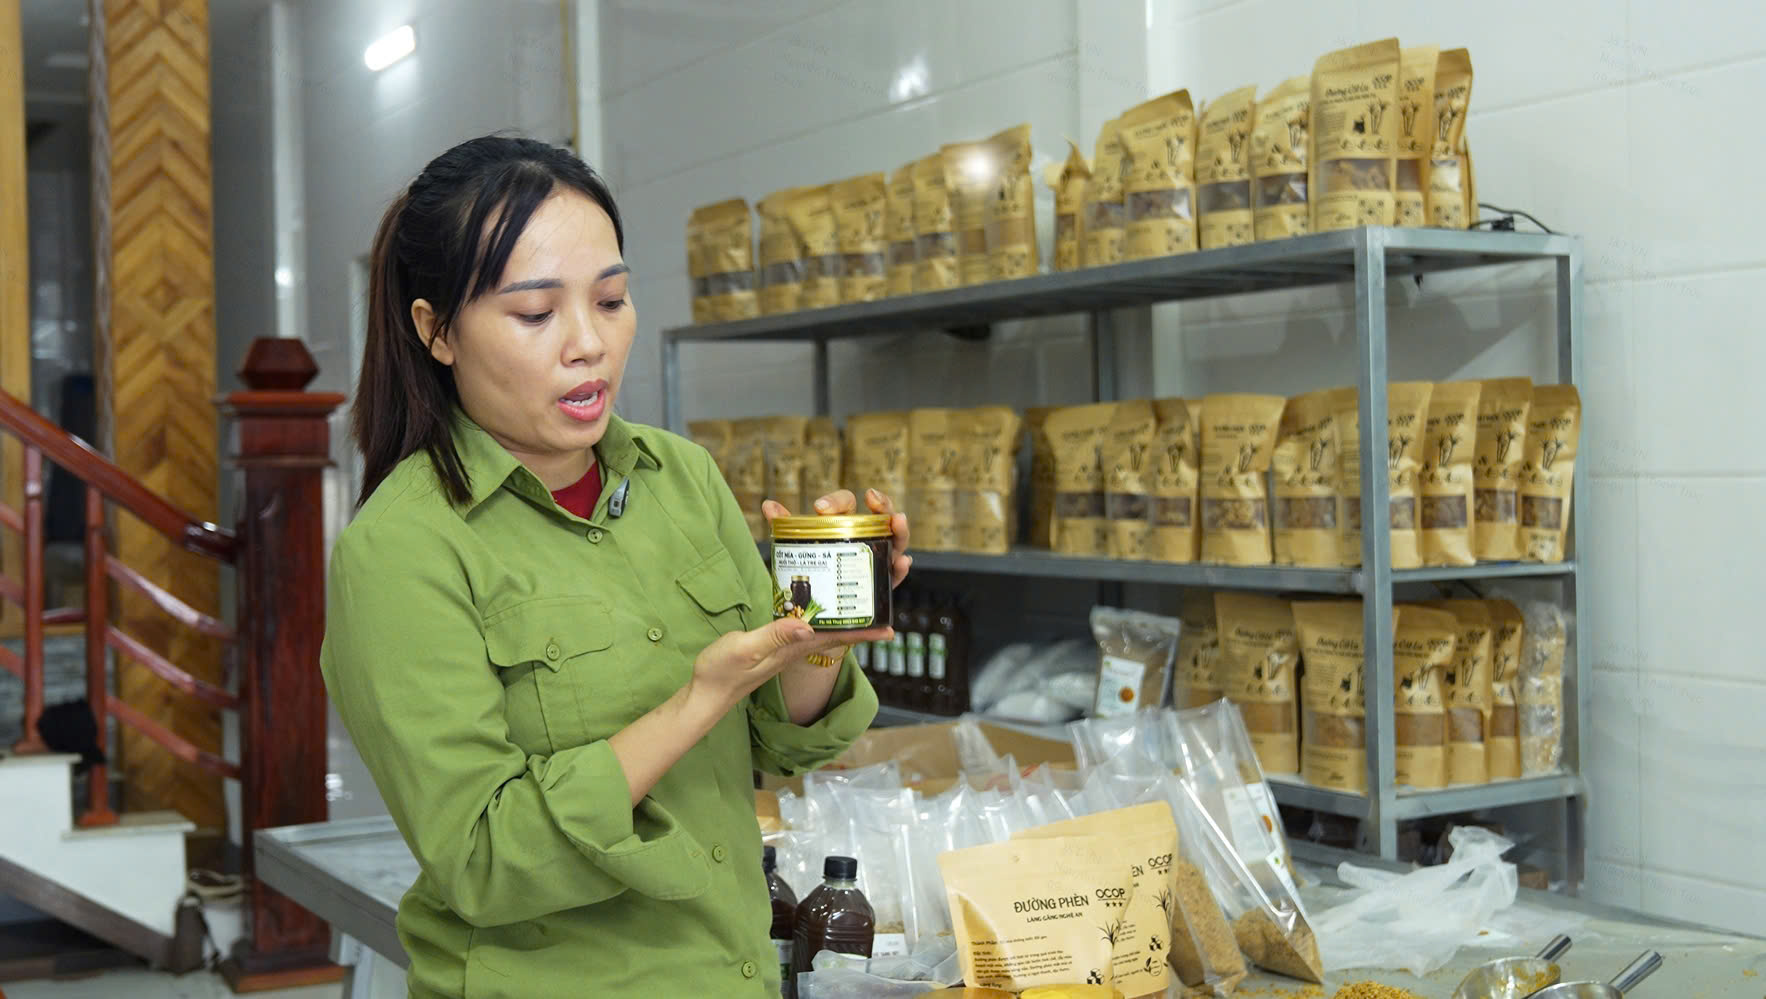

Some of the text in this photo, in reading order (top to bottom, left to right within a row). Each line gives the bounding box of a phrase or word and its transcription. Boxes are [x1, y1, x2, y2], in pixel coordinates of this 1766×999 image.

[1095, 888, 1126, 898] OCOP
[1014, 893, 1089, 913] ĐƯỜNG PHÈN
